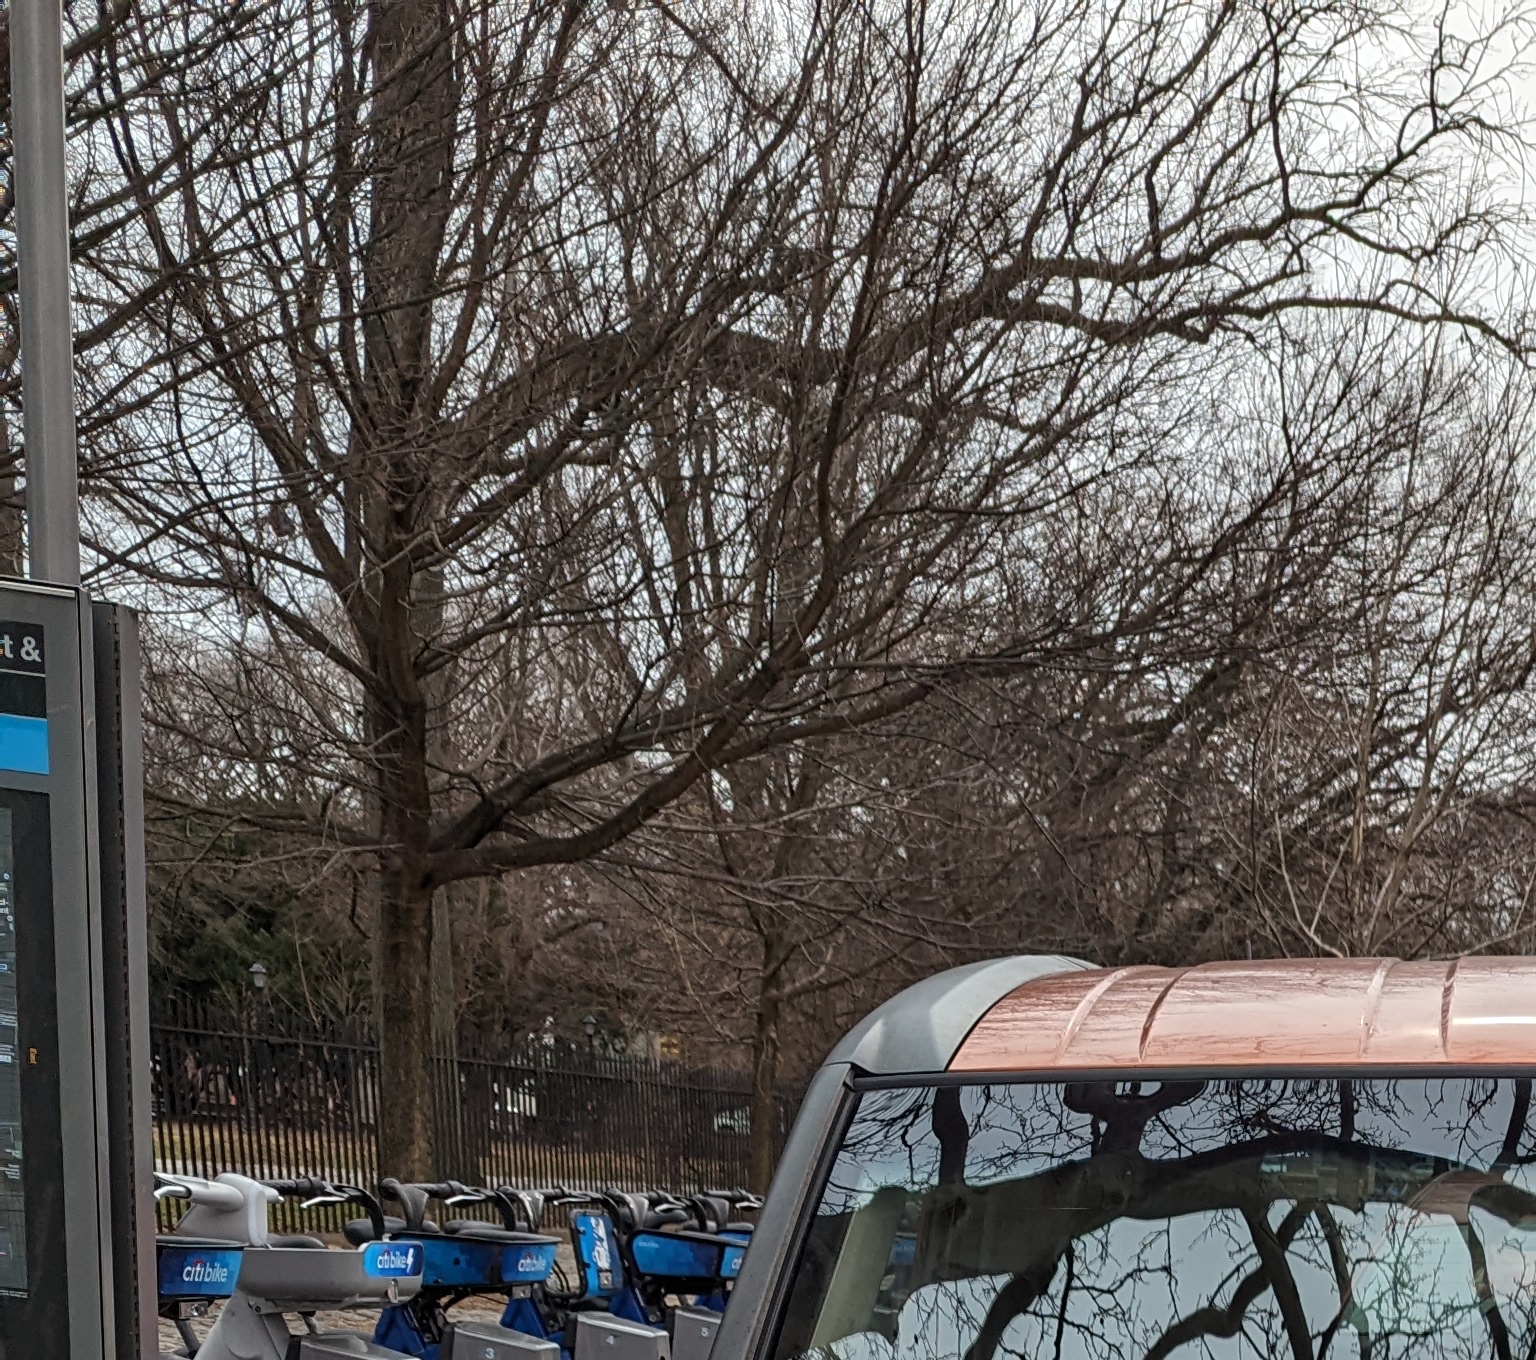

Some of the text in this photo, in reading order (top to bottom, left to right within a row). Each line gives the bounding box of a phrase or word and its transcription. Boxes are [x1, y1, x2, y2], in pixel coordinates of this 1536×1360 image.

[20, 636, 42, 662] &
[700, 1327, 709, 1338] 5
[485, 1347, 495, 1360] 3
